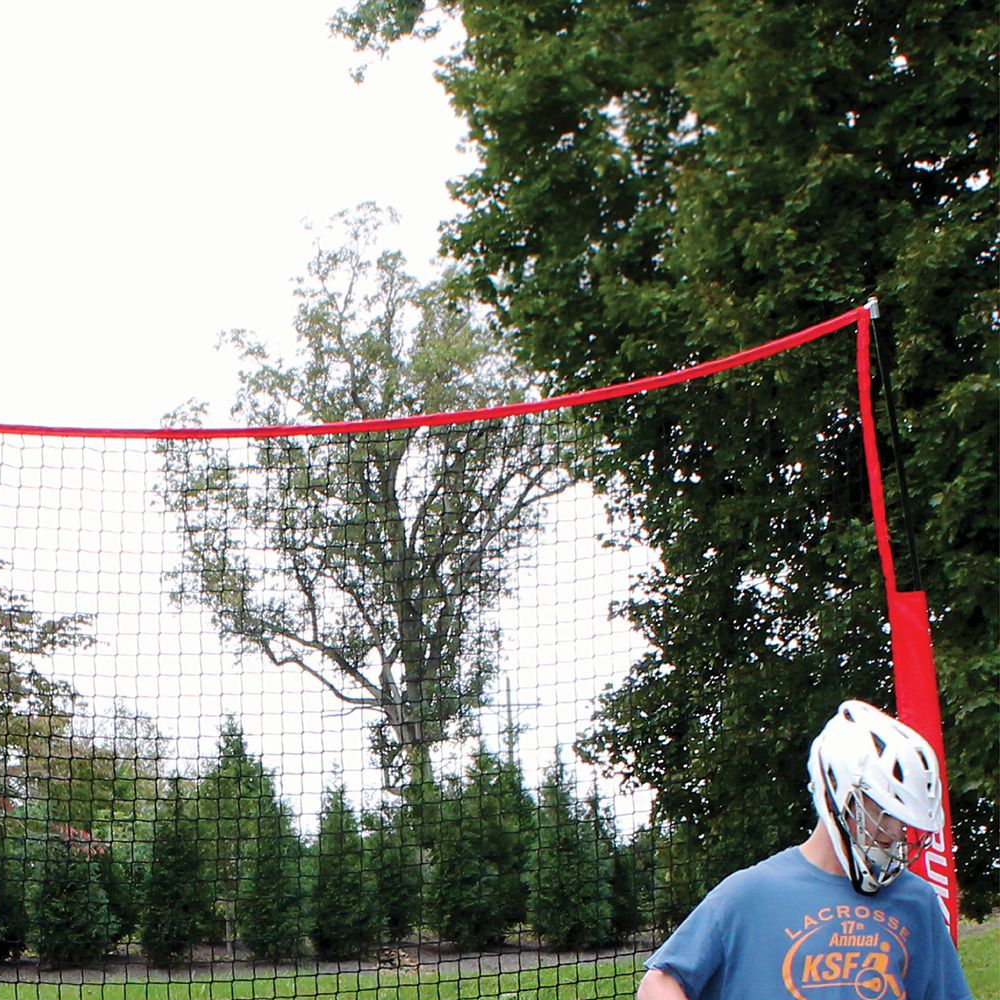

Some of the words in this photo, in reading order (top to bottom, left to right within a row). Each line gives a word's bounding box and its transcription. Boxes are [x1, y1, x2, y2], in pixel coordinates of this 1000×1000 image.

[784, 905, 910, 941] LACROSSE
[828, 933, 879, 947] Annual
[801, 951, 861, 983] KSF
